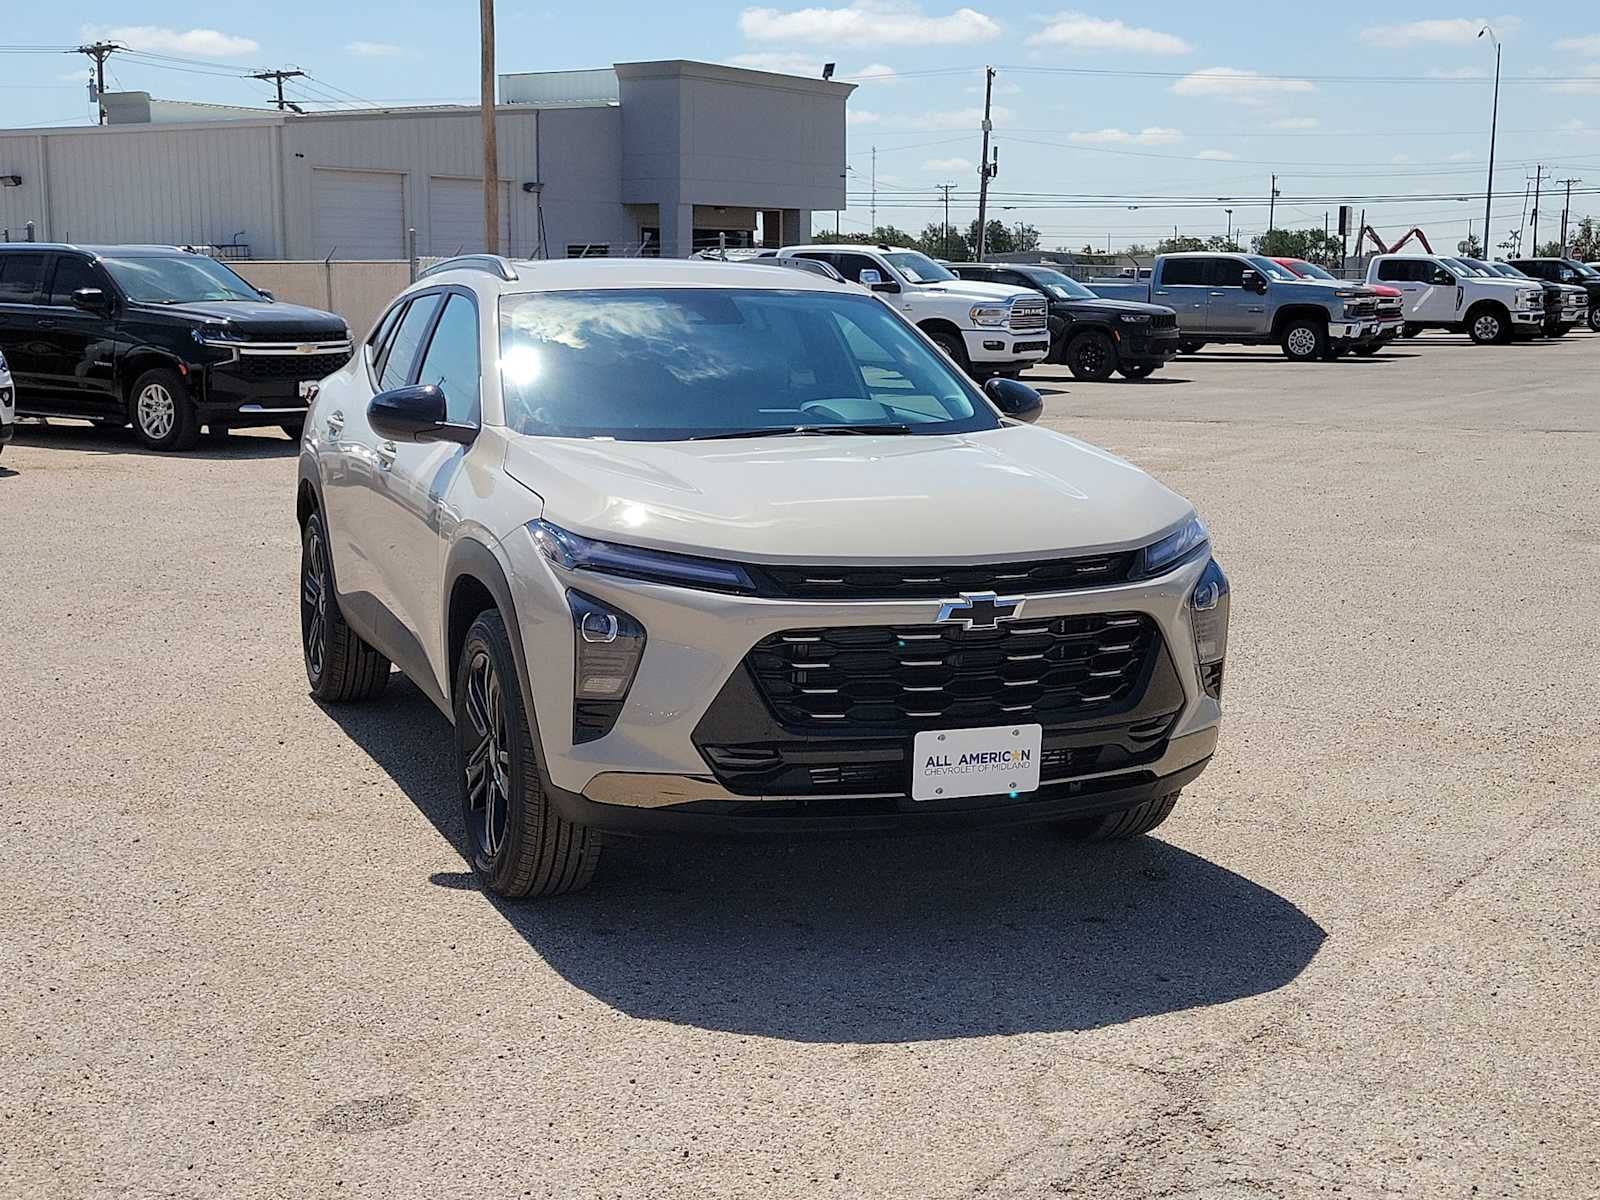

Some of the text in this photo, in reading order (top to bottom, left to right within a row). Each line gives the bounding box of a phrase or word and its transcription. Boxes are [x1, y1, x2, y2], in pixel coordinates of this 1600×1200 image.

[924, 761, 1031, 776] CHEVROLET OF MIDLAND
[925, 755, 952, 768] ALL
